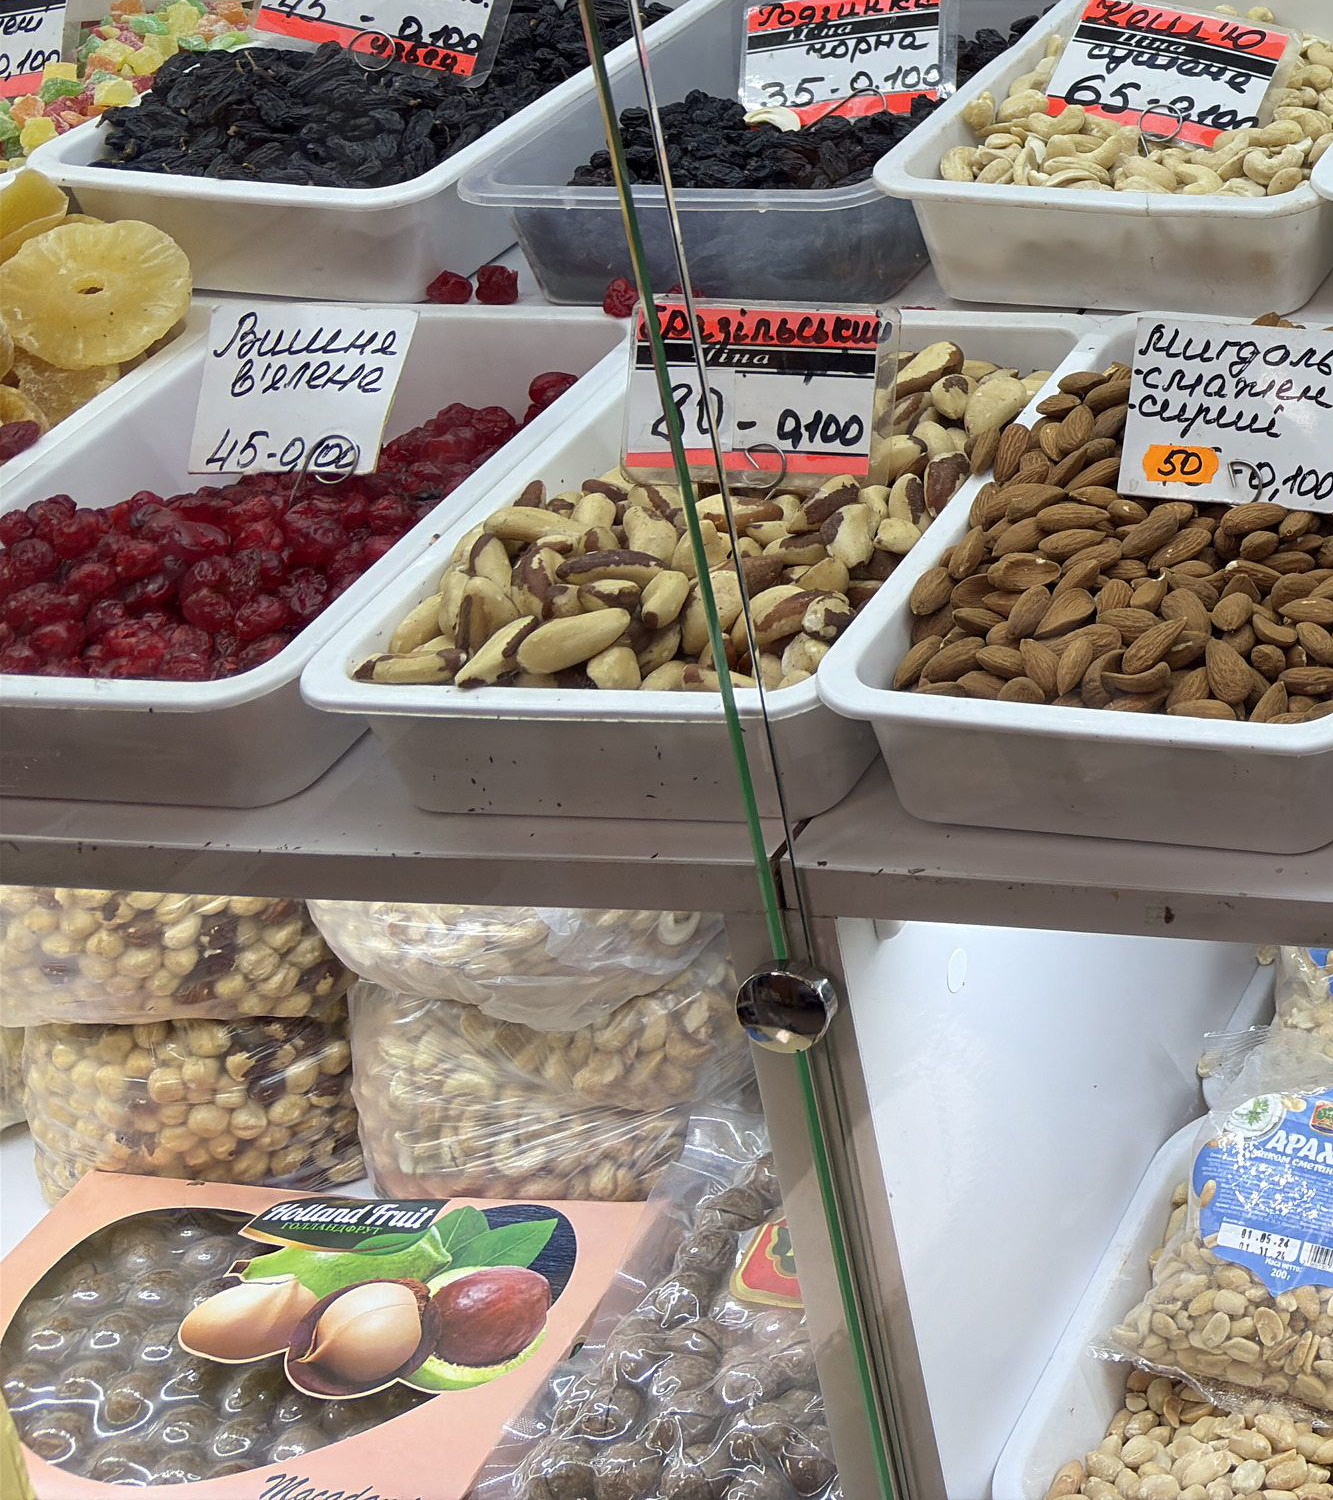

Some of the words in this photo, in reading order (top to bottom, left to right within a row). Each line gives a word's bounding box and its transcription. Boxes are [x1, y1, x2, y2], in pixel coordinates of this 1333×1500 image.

[1116, 32, 1187, 54] Ціна
[761, 75, 826, 109] 35
[1064, 74, 1142, 115] 65
[1157, 449, 1203, 476] 50
[269, 1200, 371, 1227] Holland
[367, 1204, 438, 1231] Fruit
[280, 1219, 385, 1236] ГОЛЛАНДФРУТ
[1270, 1268, 1287, 1279] 200
